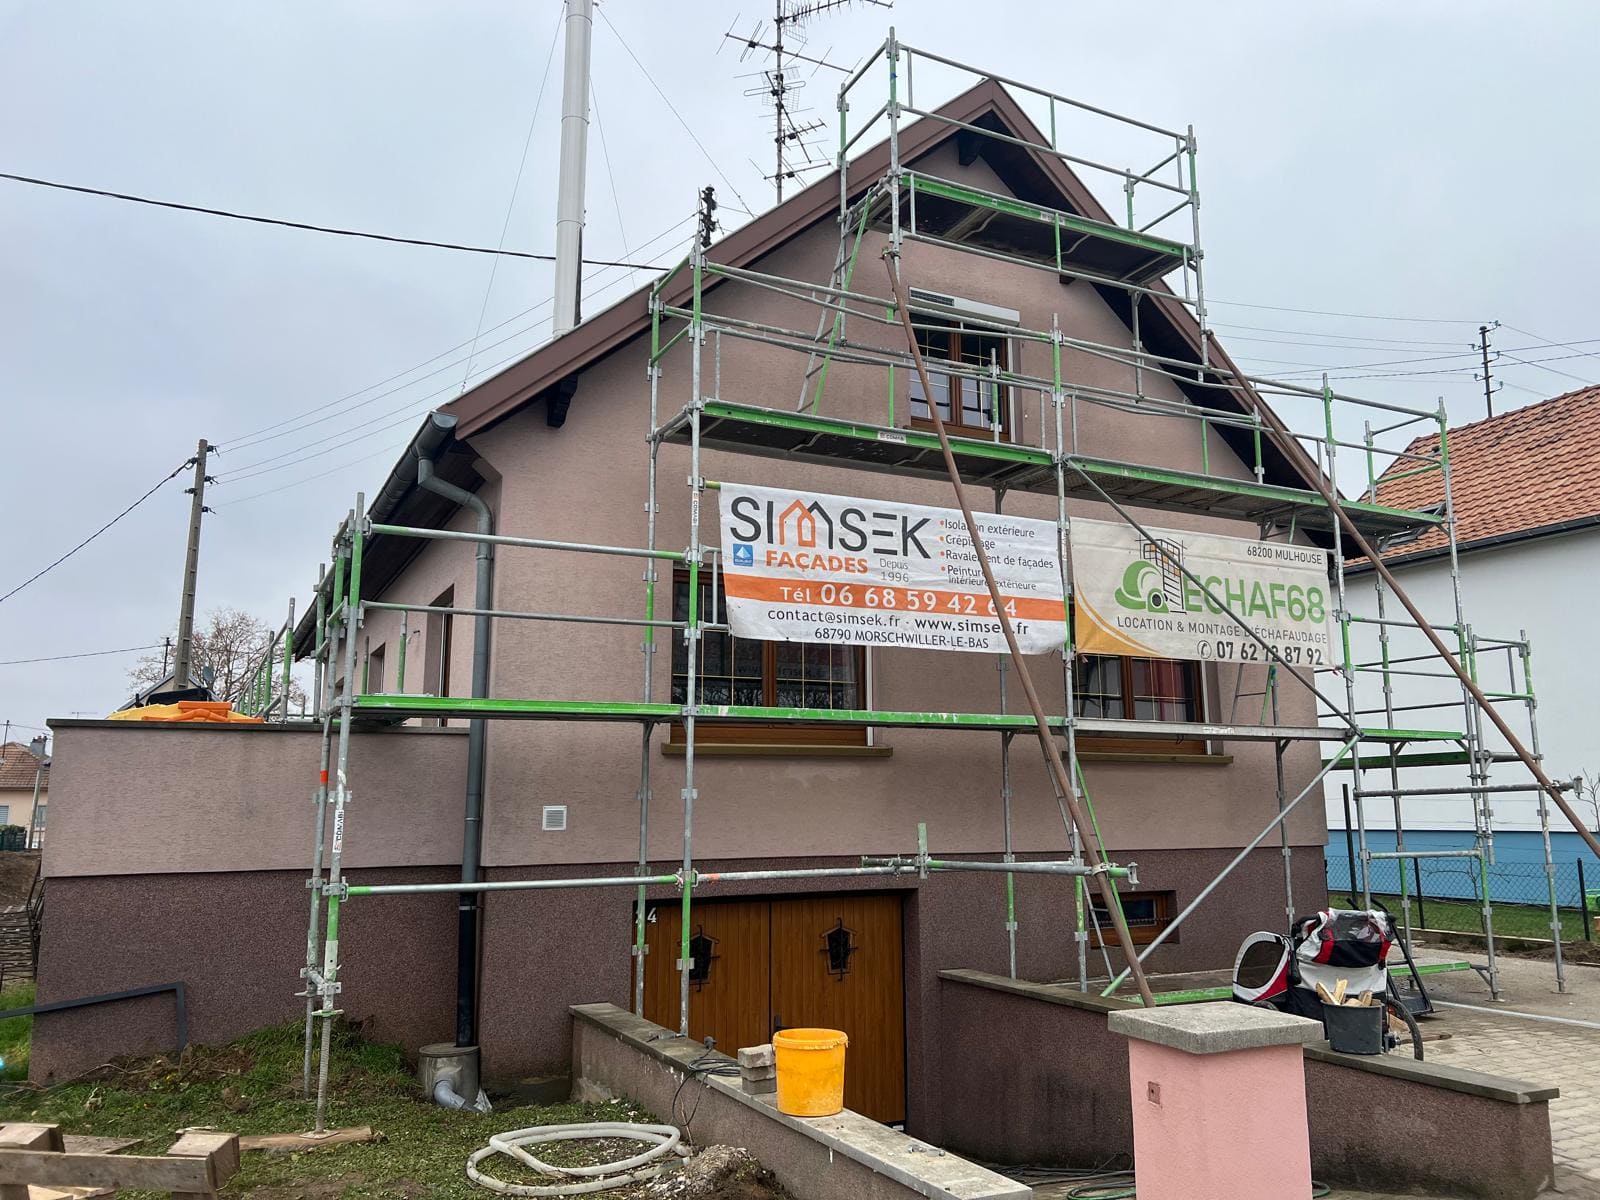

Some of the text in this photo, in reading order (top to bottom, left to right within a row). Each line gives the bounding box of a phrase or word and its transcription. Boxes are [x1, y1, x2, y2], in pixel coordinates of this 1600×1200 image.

[730, 496, 931, 559] SIMSEK
[987, 525, 1035, 538] extérieure
[766, 550, 868, 574] FAÇADES
[880, 558, 909, 571] Depuis
[946, 550, 1054, 570] Ravaleent de façades
[1247, 546, 1322, 564] 68200 MULHOUSE
[881, 572, 909, 583] 1996
[780, 586, 811, 602] Tél
[821, 584, 853, 605] 06
[865, 587, 896, 608] 68
[907, 590, 937, 611] 59
[947, 594, 977, 614] 42
[1183, 574, 1325, 624] ECHAF68
[768, 609, 901, 627] contact@simsek.fr
[914, 619, 1029, 635] www.simse.fr
[1117, 616, 1173, 632] LOCATION
[1177, 621, 1185, 633] &
[1188, 622, 1240, 637] MONTAGE
[815, 628, 989, 649] 68790 MORSCHWILLER-LE-BAS
[1216, 640, 1234, 660] 07
[1240, 643, 1258, 661] 62
[1284, 646, 1301, 664] 87
[1306, 647, 1324, 666] 92
